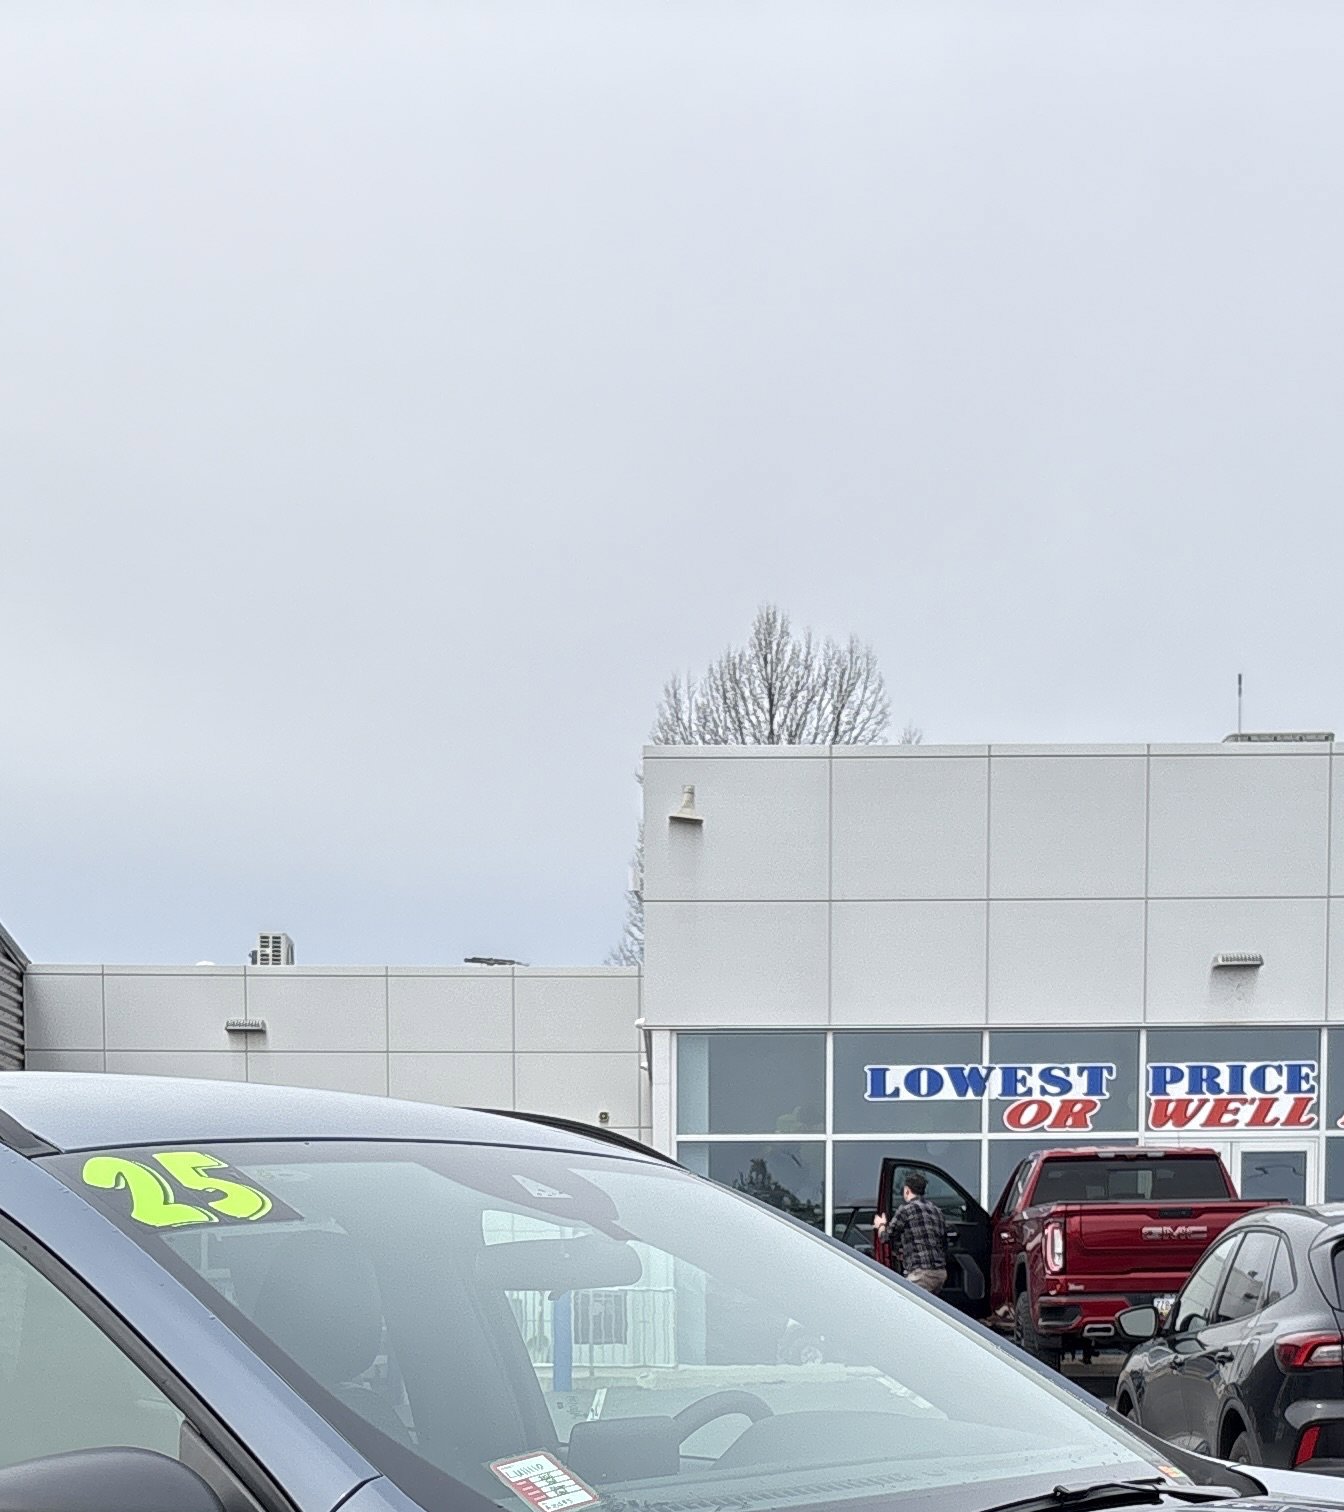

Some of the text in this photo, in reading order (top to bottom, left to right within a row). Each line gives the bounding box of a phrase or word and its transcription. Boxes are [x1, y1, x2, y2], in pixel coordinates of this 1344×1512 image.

[868, 1066, 1114, 1099] LOWEST
[1148, 1063, 1317, 1096] PRICE
[1006, 1098, 1099, 1129] OR
[82, 1151, 272, 1227] 25
[1141, 1225, 1208, 1240] GMC
